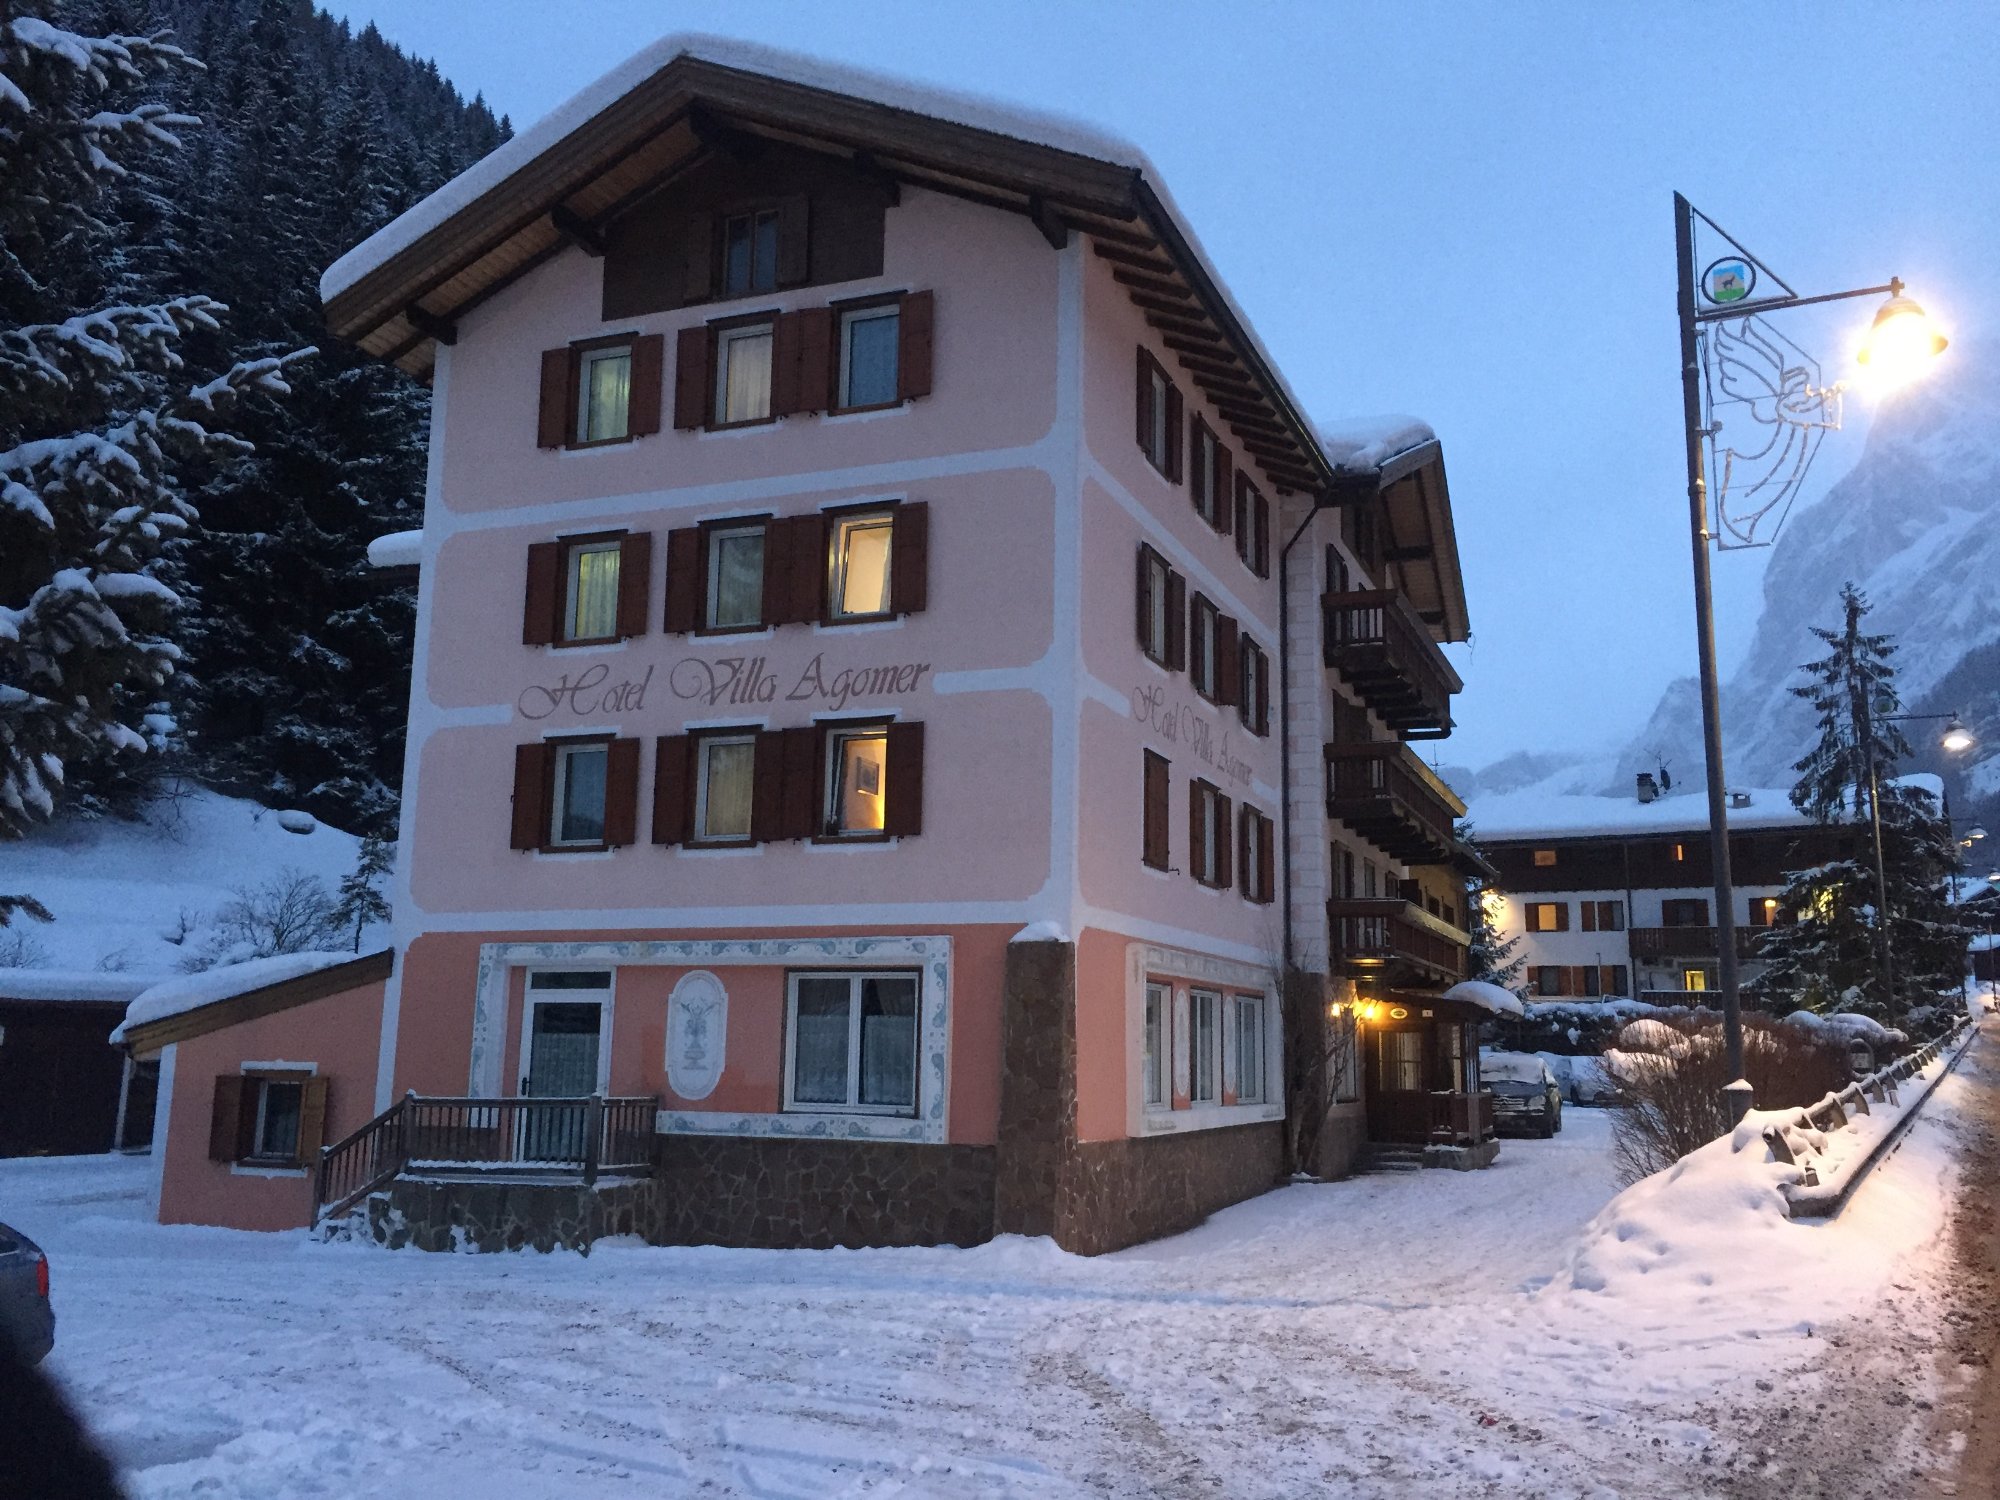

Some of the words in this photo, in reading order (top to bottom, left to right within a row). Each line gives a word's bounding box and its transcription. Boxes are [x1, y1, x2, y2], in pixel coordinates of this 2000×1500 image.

[518, 664, 655, 720] Hotel
[669, 656, 777, 706] Villa
[785, 652, 931, 711] Agomer
